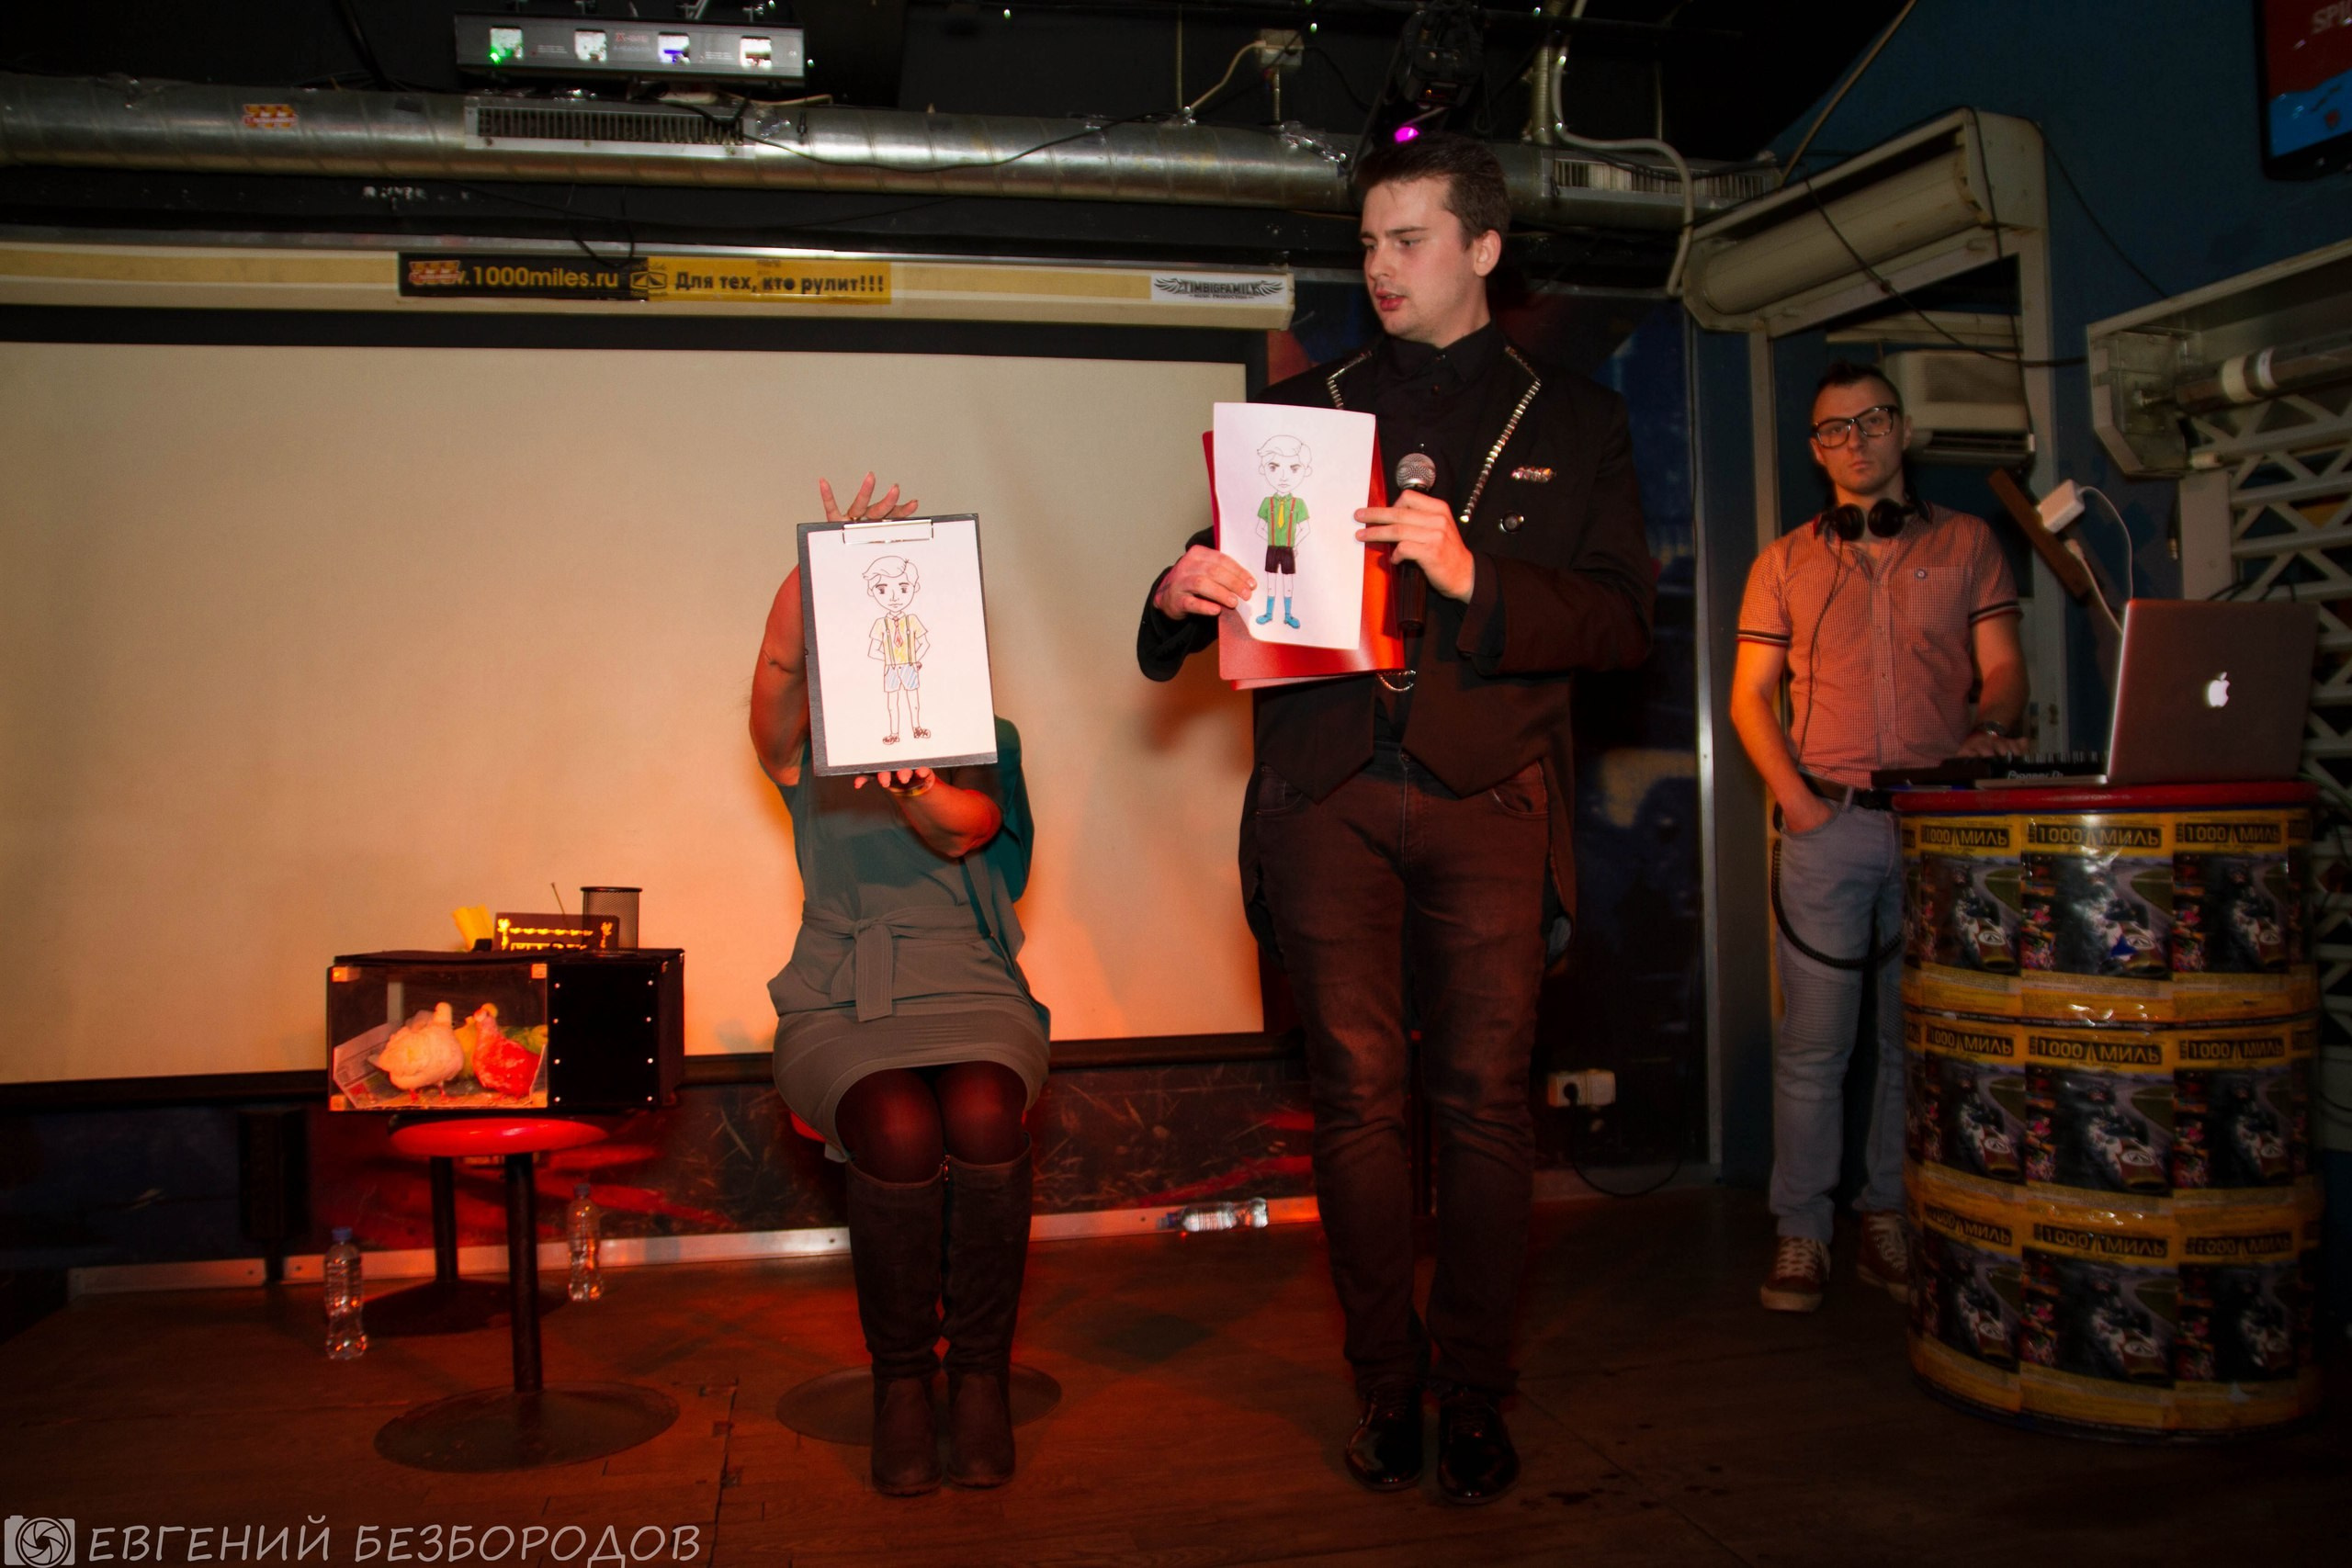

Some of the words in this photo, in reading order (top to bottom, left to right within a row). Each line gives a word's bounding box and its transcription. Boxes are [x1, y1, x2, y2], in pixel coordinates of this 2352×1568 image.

[675, 271, 713, 291] Для
[718, 276, 757, 293] тех,
[762, 276, 796, 290] кто
[800, 275, 884, 295] рулит!!!
[1924, 828, 1951, 843] 1000
[1961, 829, 2007, 846] МИЛЬ
[2039, 827, 2083, 843] 1000
[2100, 829, 2161, 847] МИЛЬ
[2188, 826, 2227, 842] 1000
[1964, 1034, 2013, 1055] МИЛЬ
[2040, 1039, 2084, 1059] 1000
[2100, 1043, 2162, 1064] МИЛЬ
[2191, 1042, 2231, 1058] 1000
[2042, 1226, 2089, 1248] 1000
[2107, 1236, 2167, 1258] МИЛЬ
